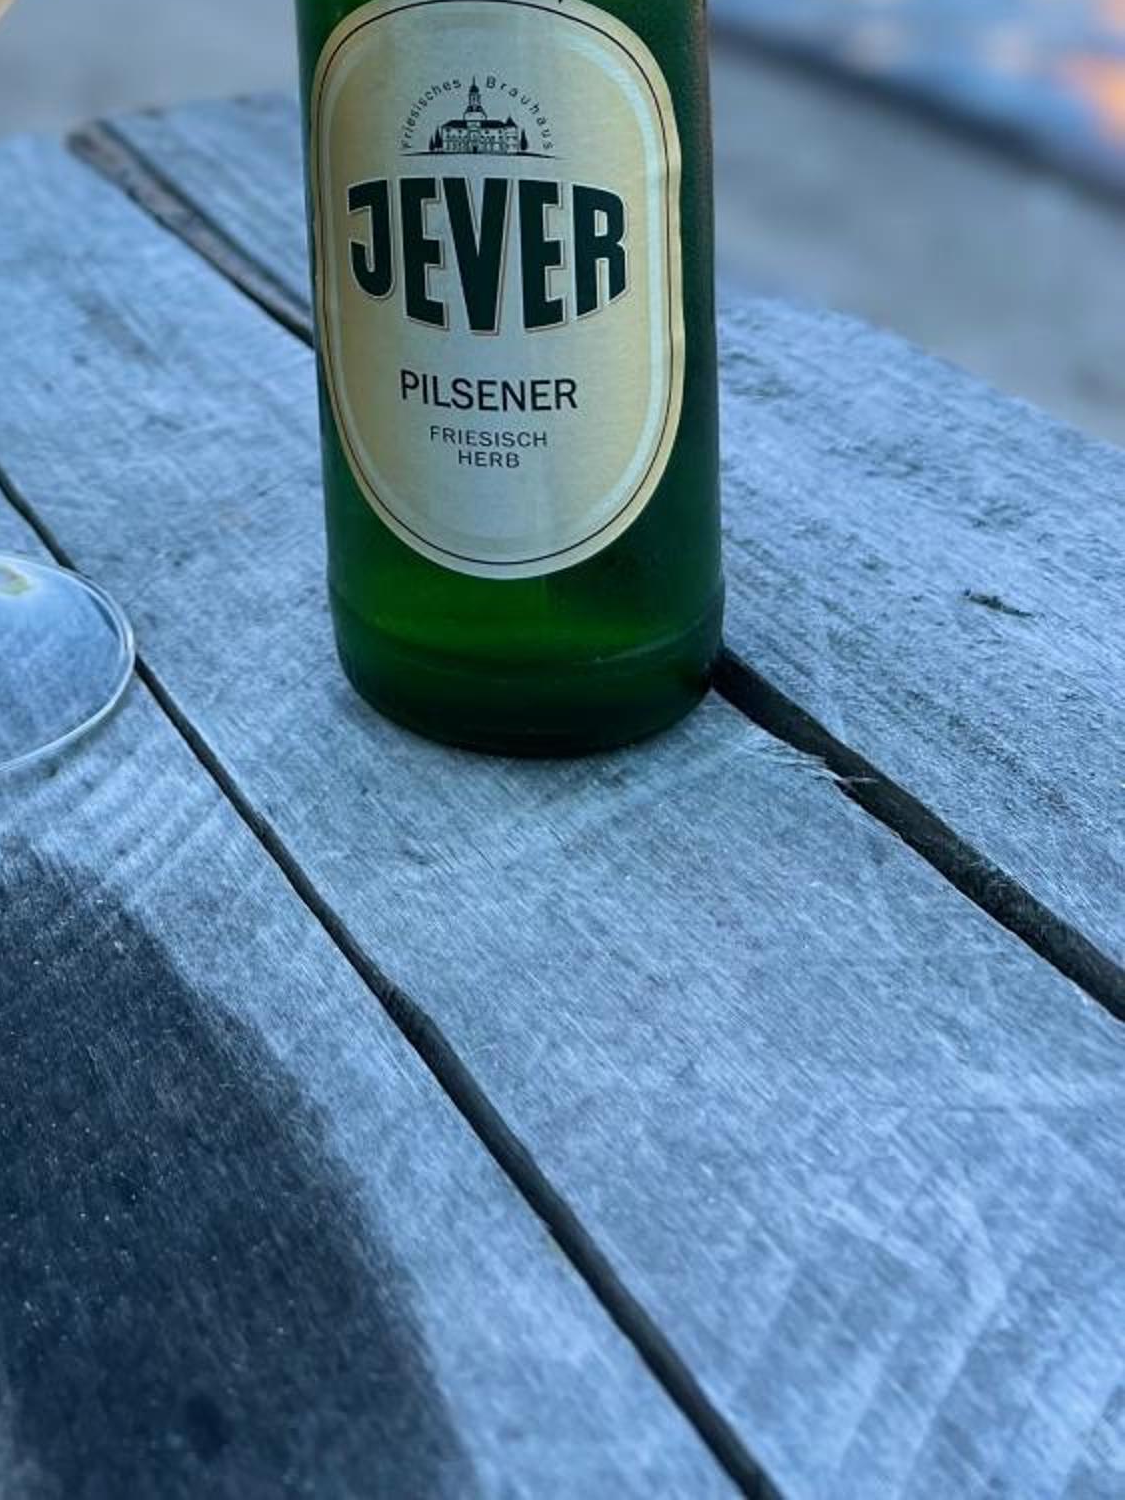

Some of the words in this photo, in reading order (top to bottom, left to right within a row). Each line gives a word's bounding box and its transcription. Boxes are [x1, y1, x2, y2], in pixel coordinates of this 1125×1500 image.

[400, 79, 462, 149] Friesisches
[486, 75, 553, 150] Brauhaus
[347, 177, 629, 335] JEVER
[400, 369, 578, 412] PILSENER
[430, 425, 548, 448] FRIESISCH
[457, 449, 520, 469] HERB
